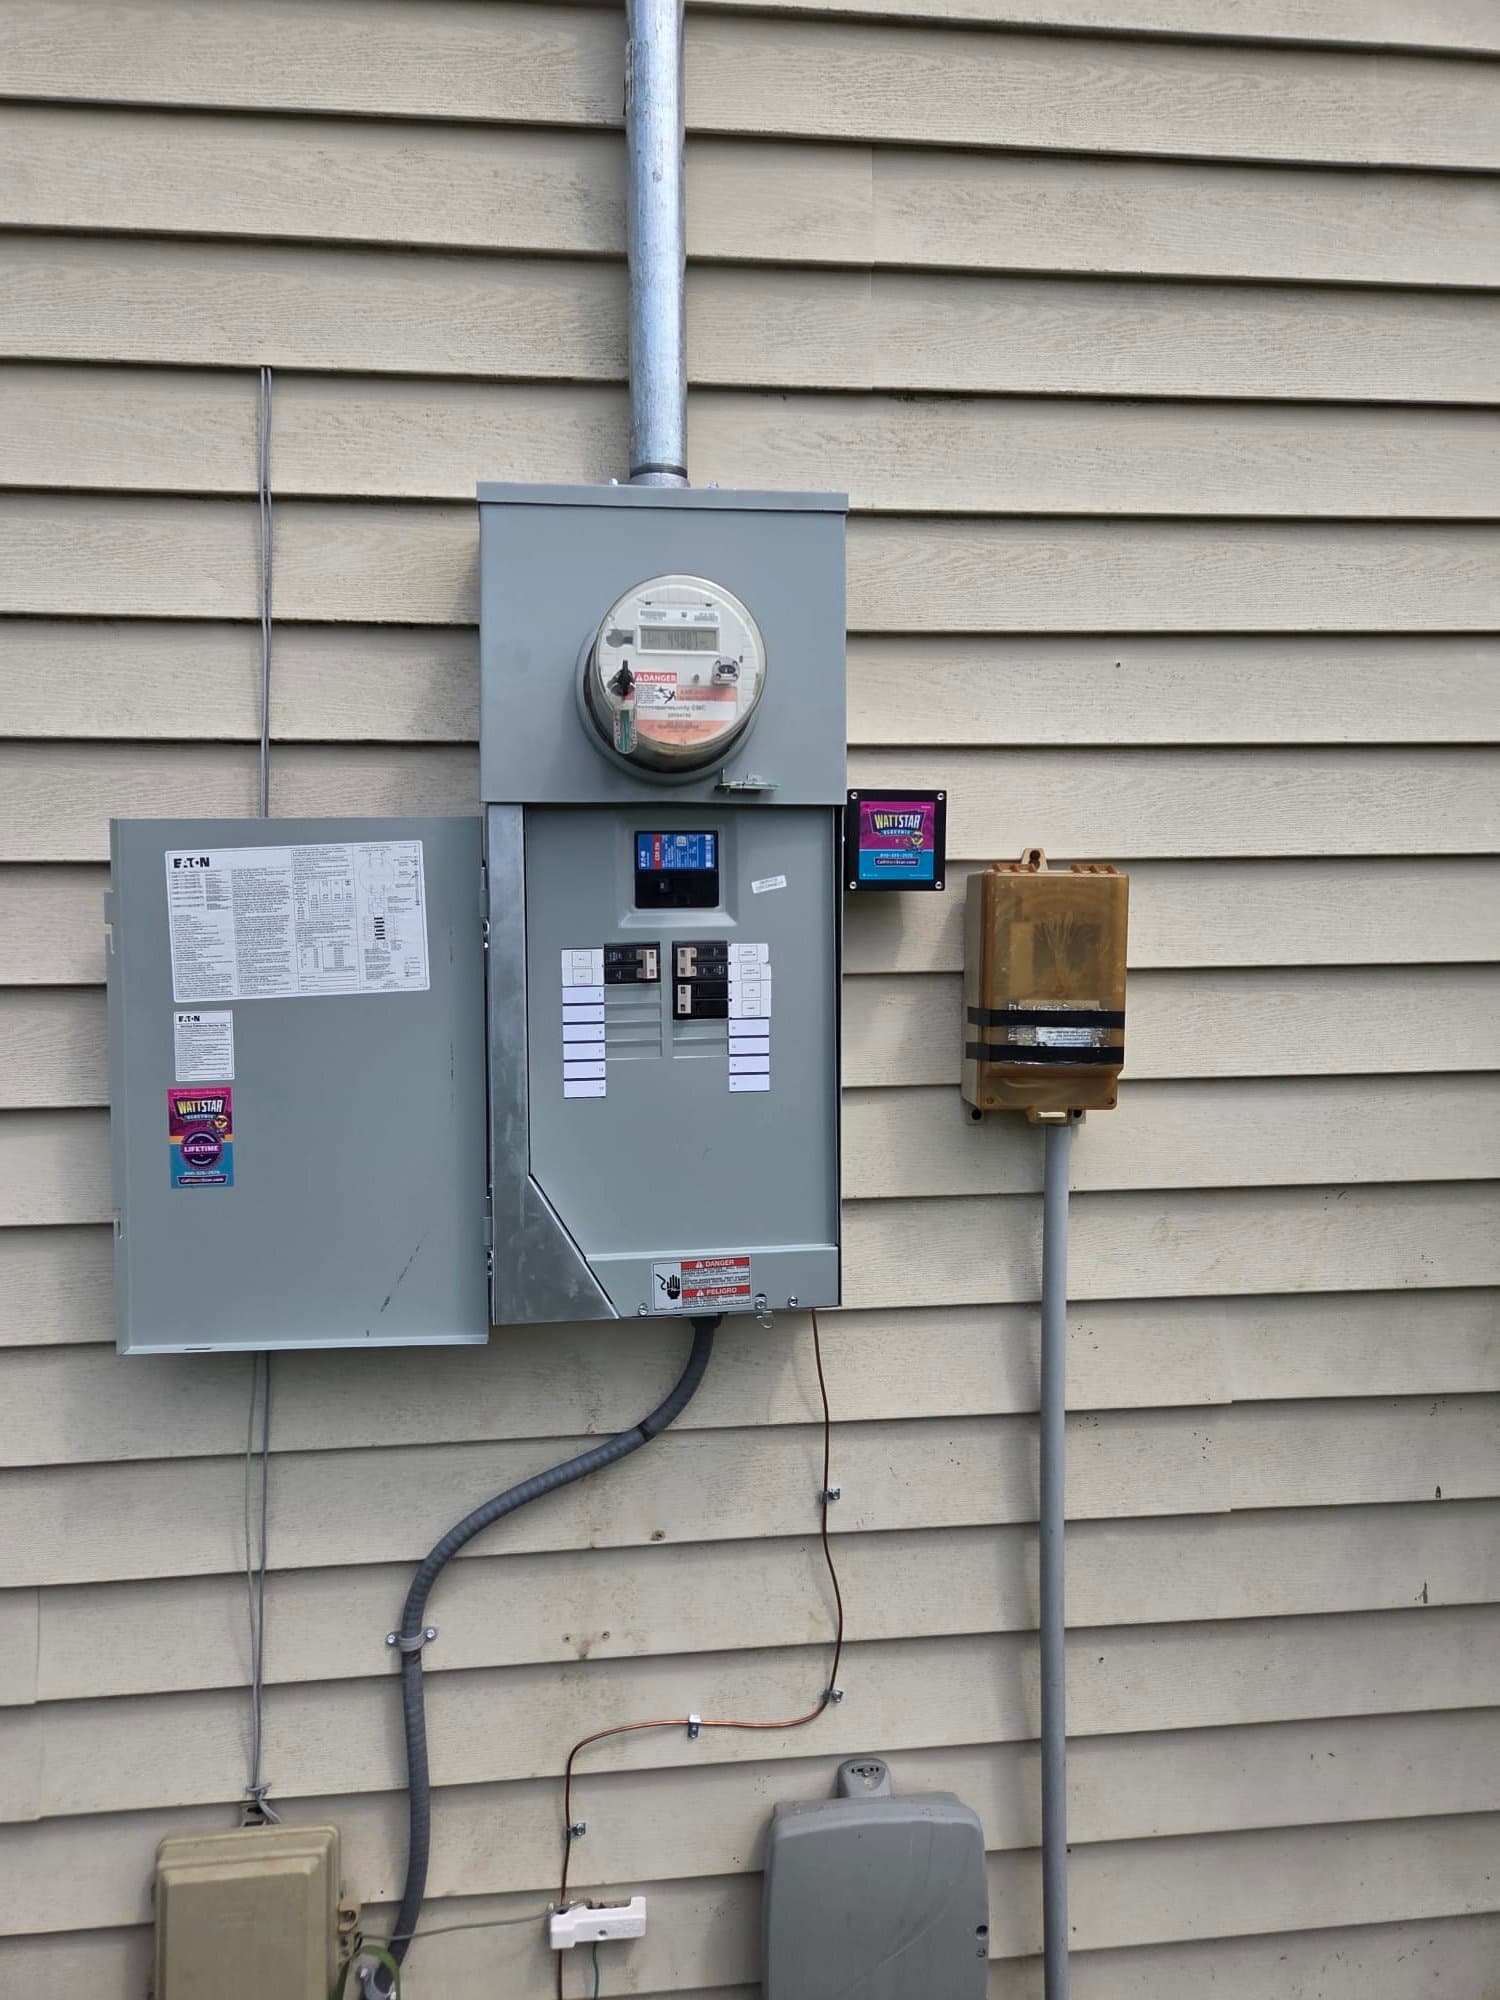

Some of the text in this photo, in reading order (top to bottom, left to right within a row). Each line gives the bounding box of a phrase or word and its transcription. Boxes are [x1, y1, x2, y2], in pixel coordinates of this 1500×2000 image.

[643, 674, 677, 682] DANGER
[874, 814, 921, 829] WATTSTAR
[176, 1099, 223, 1114] WATTSTAR
[183, 1145, 220, 1153] LIFETIME
[705, 1259, 734, 1267] DANGER
[706, 1287, 737, 1295] PELIGRO
